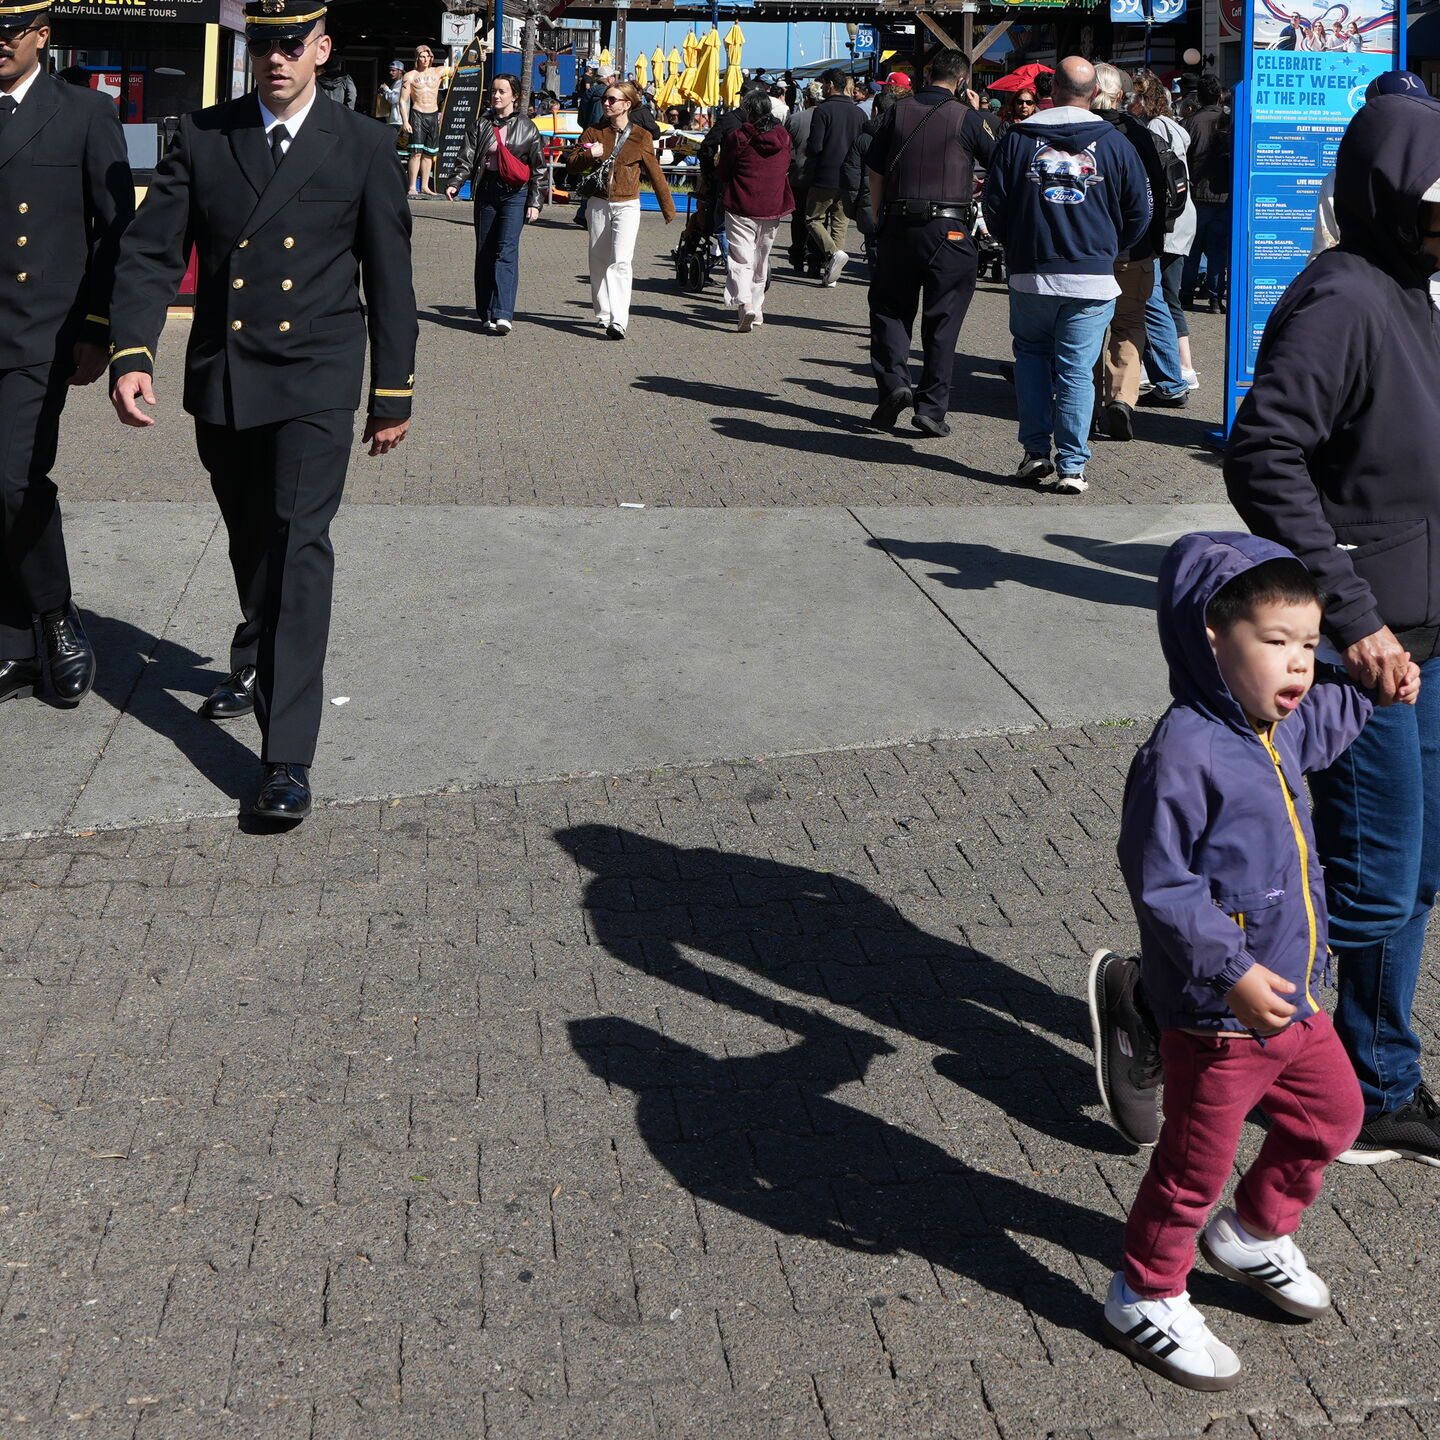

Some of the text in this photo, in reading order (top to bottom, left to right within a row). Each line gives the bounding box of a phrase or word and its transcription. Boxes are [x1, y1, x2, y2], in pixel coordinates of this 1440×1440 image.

[54, 5, 177, 18] HALF/FULL DAY WINE TOURS
[857, 35, 874, 47] 39
[1257, 55, 1322, 71] CELEBRATE
[1257, 73, 1359, 90] FLEET WEEK
[1256, 90, 1326, 106] AT THE PIER
[1050, 188, 1077, 202] Ford
